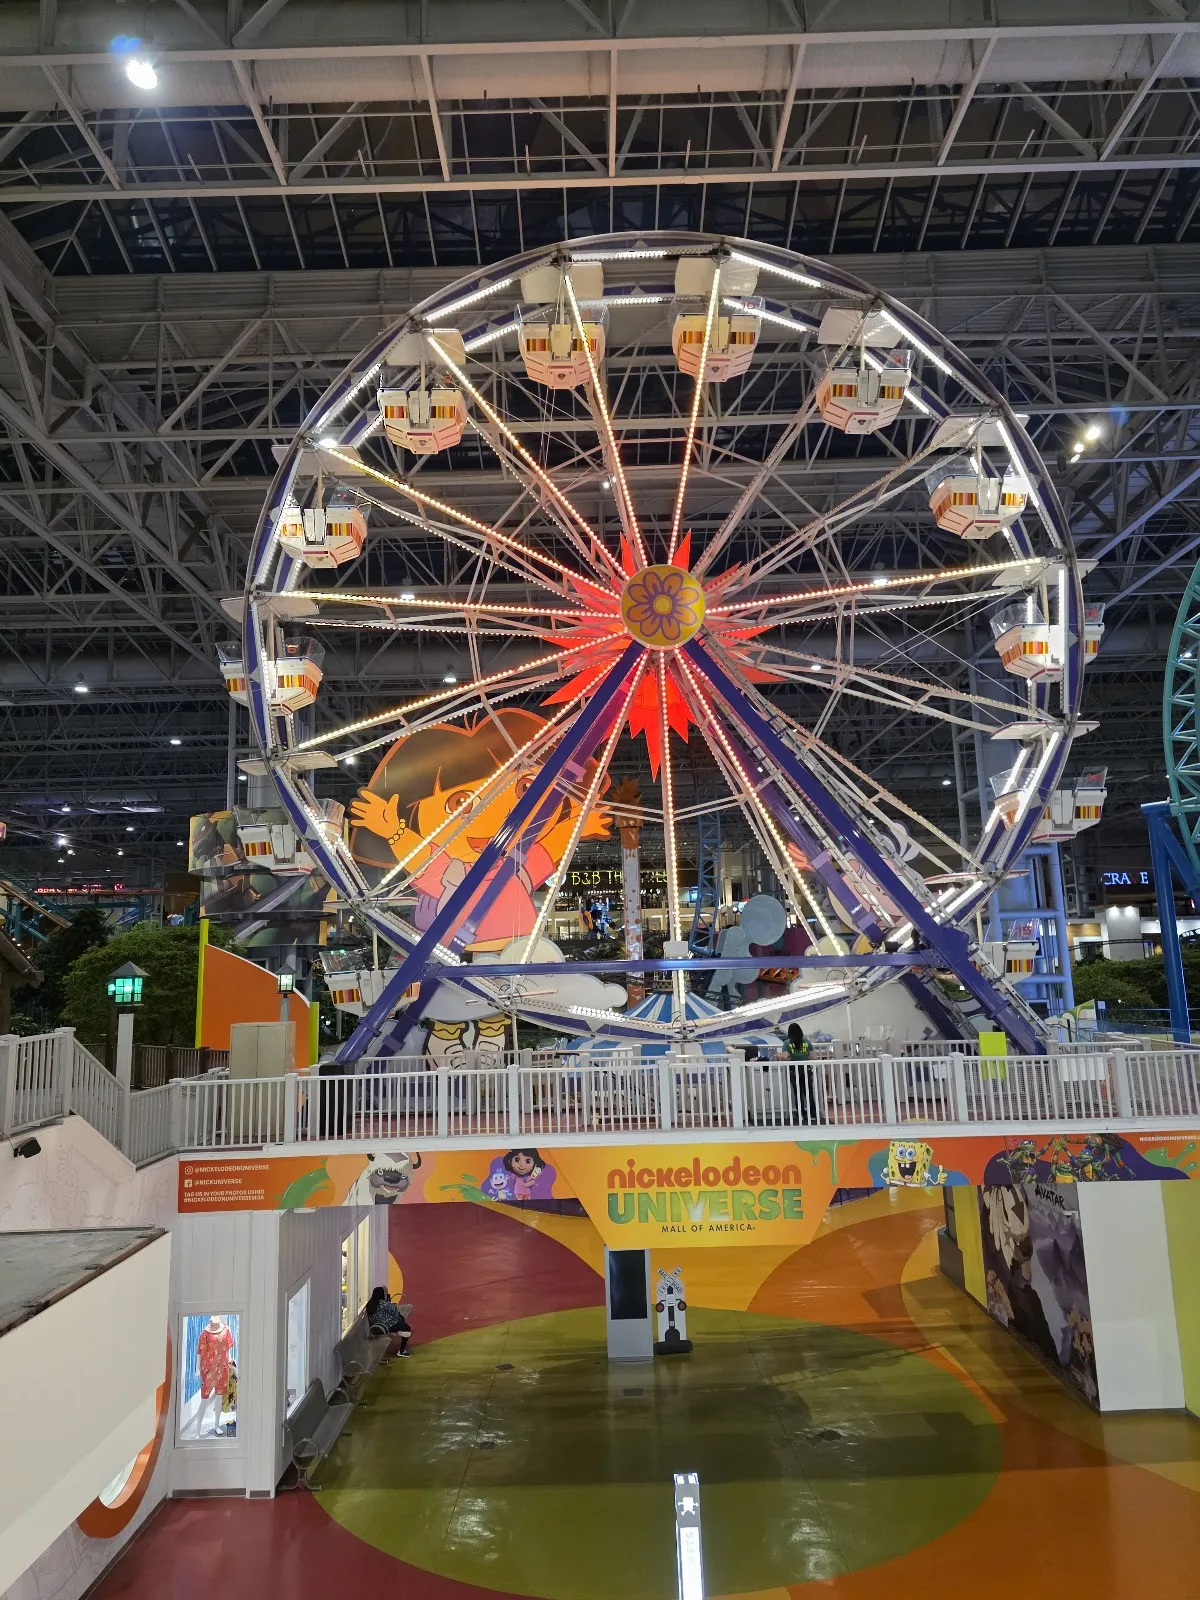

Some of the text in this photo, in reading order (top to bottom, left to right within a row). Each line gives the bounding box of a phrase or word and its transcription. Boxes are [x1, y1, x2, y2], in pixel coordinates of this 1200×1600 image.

[571, 870, 601, 886] B&B
[1103, 871, 1149, 885] CRAVE
[194, 1164, 270, 1174] @NICKELODEONUNIVERSE
[607, 1155, 802, 1189] nickelodeon
[193, 1178, 243, 1187] @NICKUNIVERSE
[1035, 1183, 1065, 1210] AVATAR
[607, 1188, 804, 1224] UNIVERSE
[661, 1225, 686, 1233] MALL
[691, 1224, 703, 1232] OF
